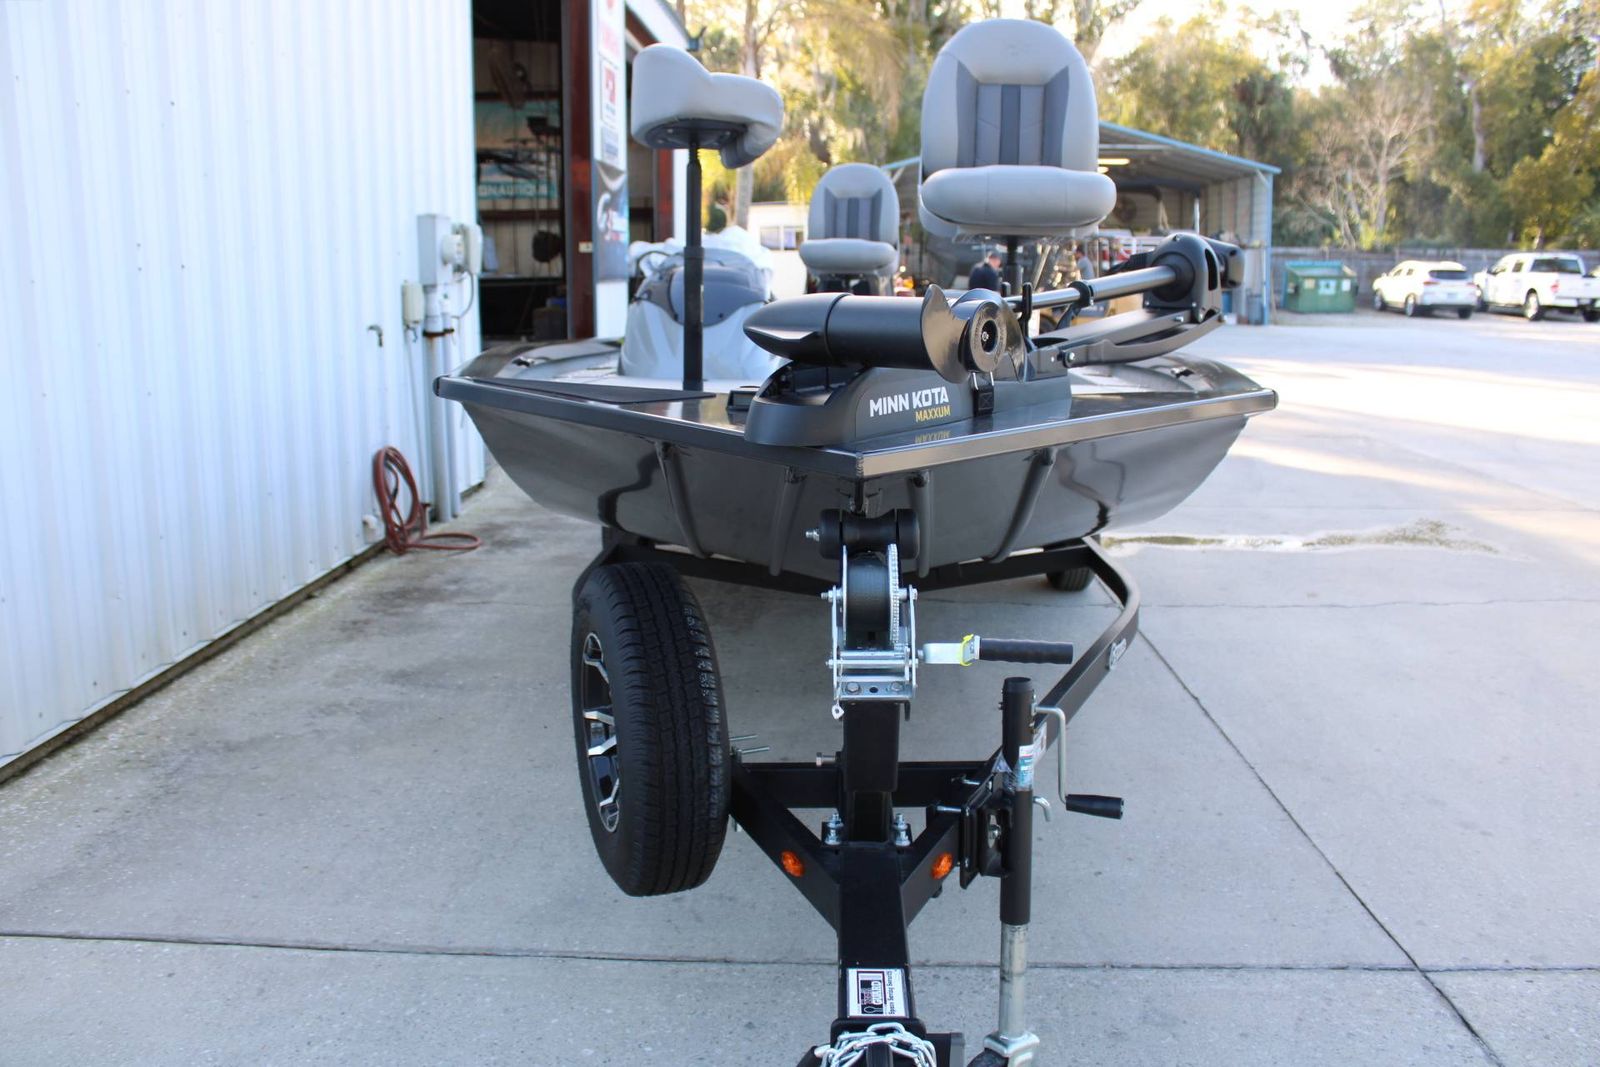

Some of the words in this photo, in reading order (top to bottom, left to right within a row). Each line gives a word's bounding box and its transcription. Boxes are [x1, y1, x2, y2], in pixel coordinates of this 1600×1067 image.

[869, 393, 910, 417] MINN
[912, 386, 949, 409] KOTA
[915, 405, 951, 423] MAXXUM
